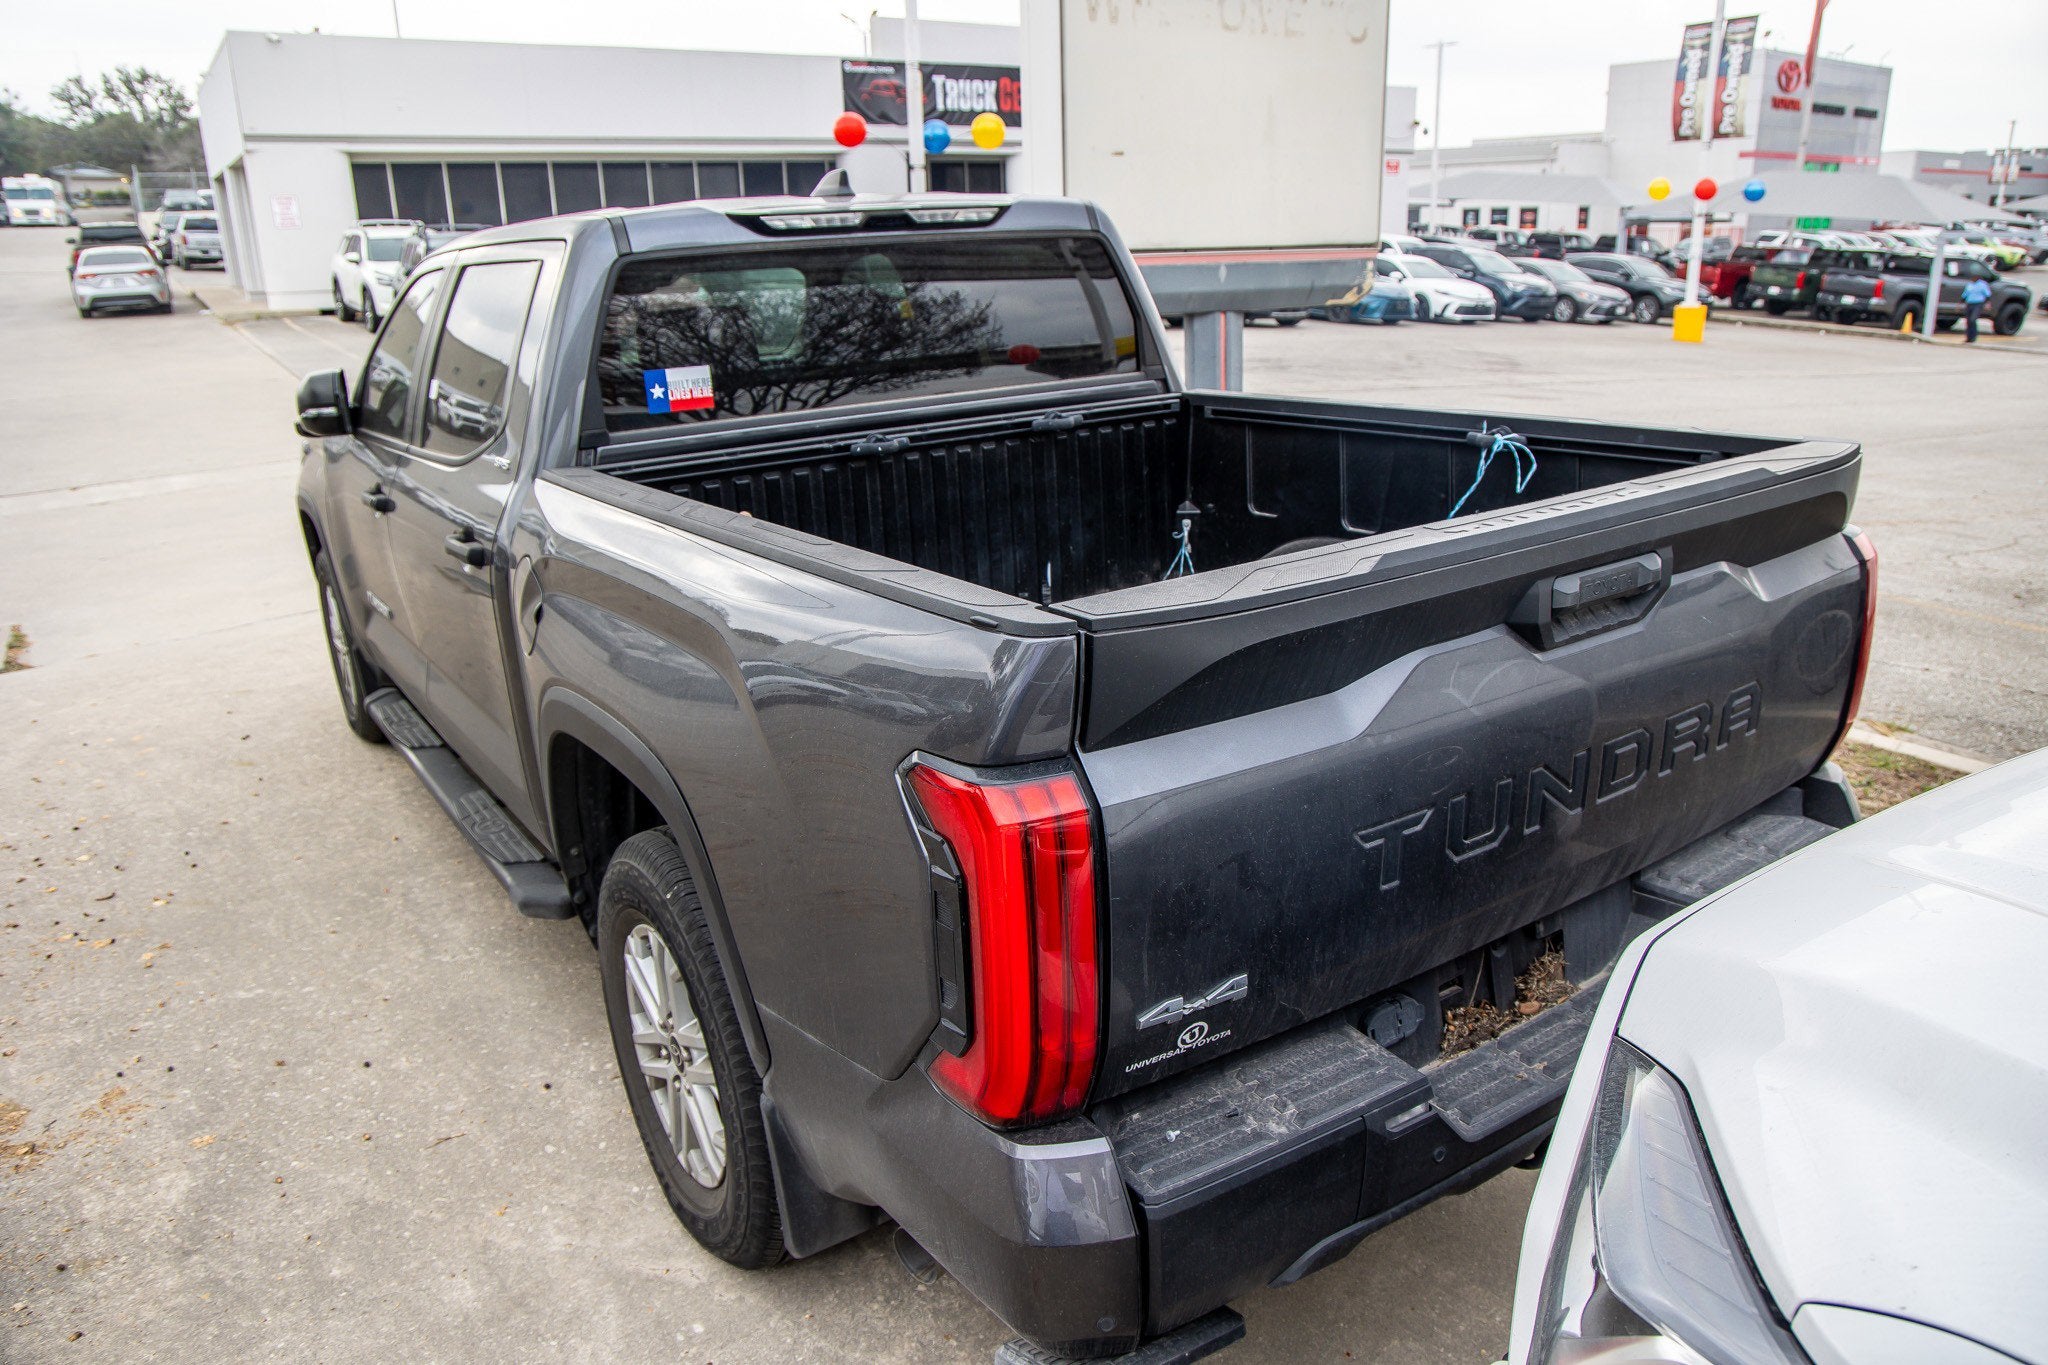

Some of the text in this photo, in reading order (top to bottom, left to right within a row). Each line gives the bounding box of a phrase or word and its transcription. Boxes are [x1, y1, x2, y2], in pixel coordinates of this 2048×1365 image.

[1584, 572, 1632, 598] TOYOTA
[1354, 681, 1763, 891] TUNDRA
[1125, 1030, 1231, 1072] UNIVERSAL TOYOTA
